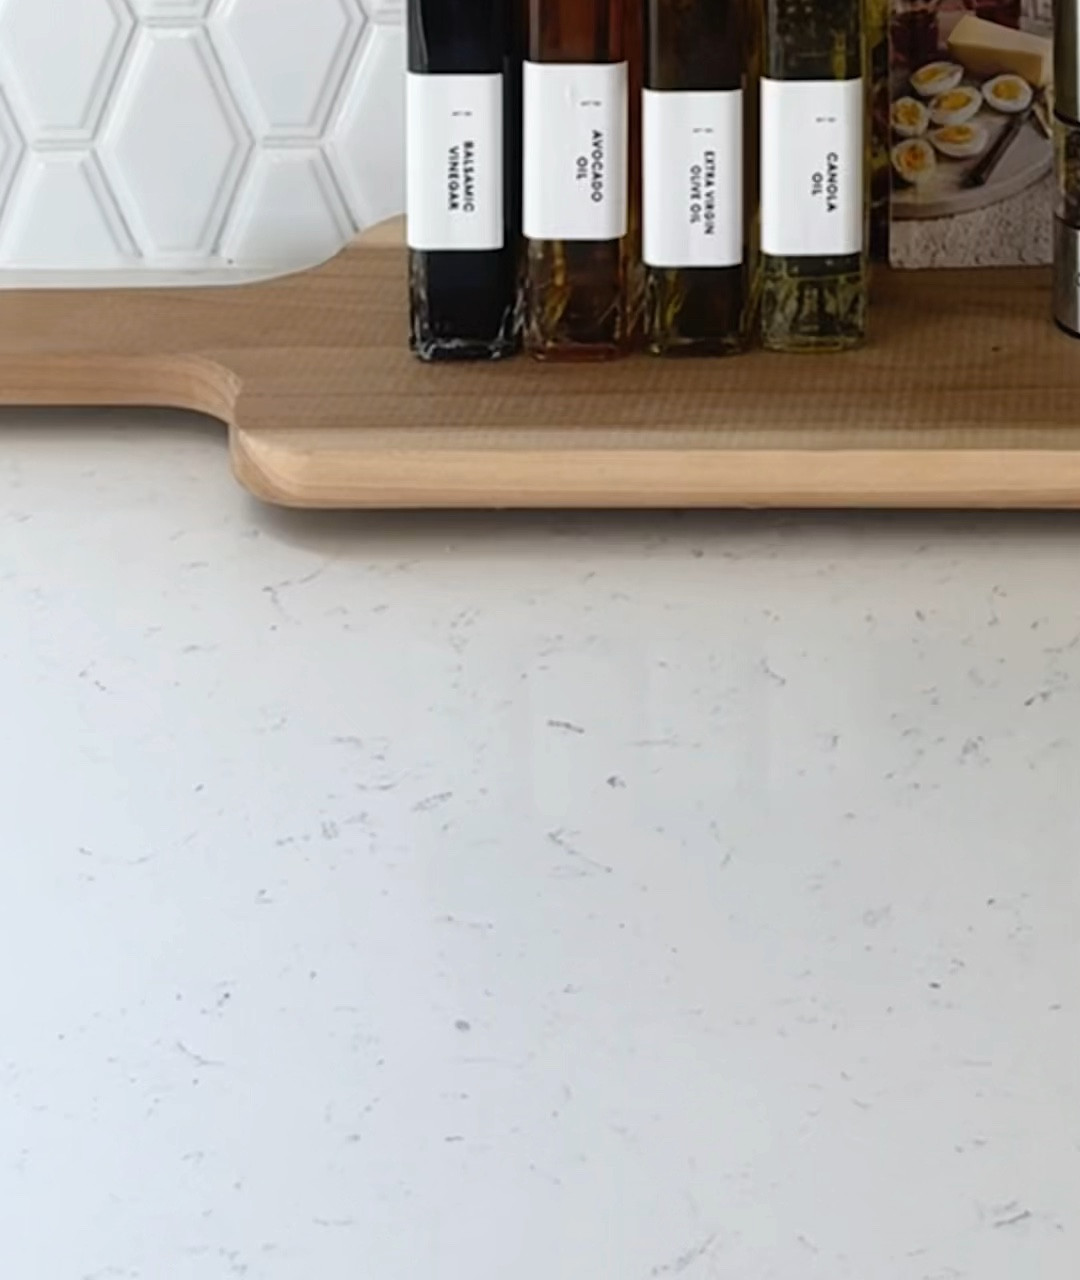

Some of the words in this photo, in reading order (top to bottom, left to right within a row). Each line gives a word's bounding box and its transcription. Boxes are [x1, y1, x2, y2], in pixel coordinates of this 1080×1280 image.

[448, 146, 460, 211] VINEGAR
[463, 140, 475, 213] BALSAMIC
[576, 155, 588, 181] OIL
[591, 129, 604, 203] AVOCADO
[690, 164, 702, 200] OLIVE
[704, 150, 716, 188] EXTRA
[811, 171, 824, 197] OIL
[826, 151, 839, 213] CANOLA
[690, 203, 702, 224] OIL
[704, 190, 716, 236] VIRGIN
